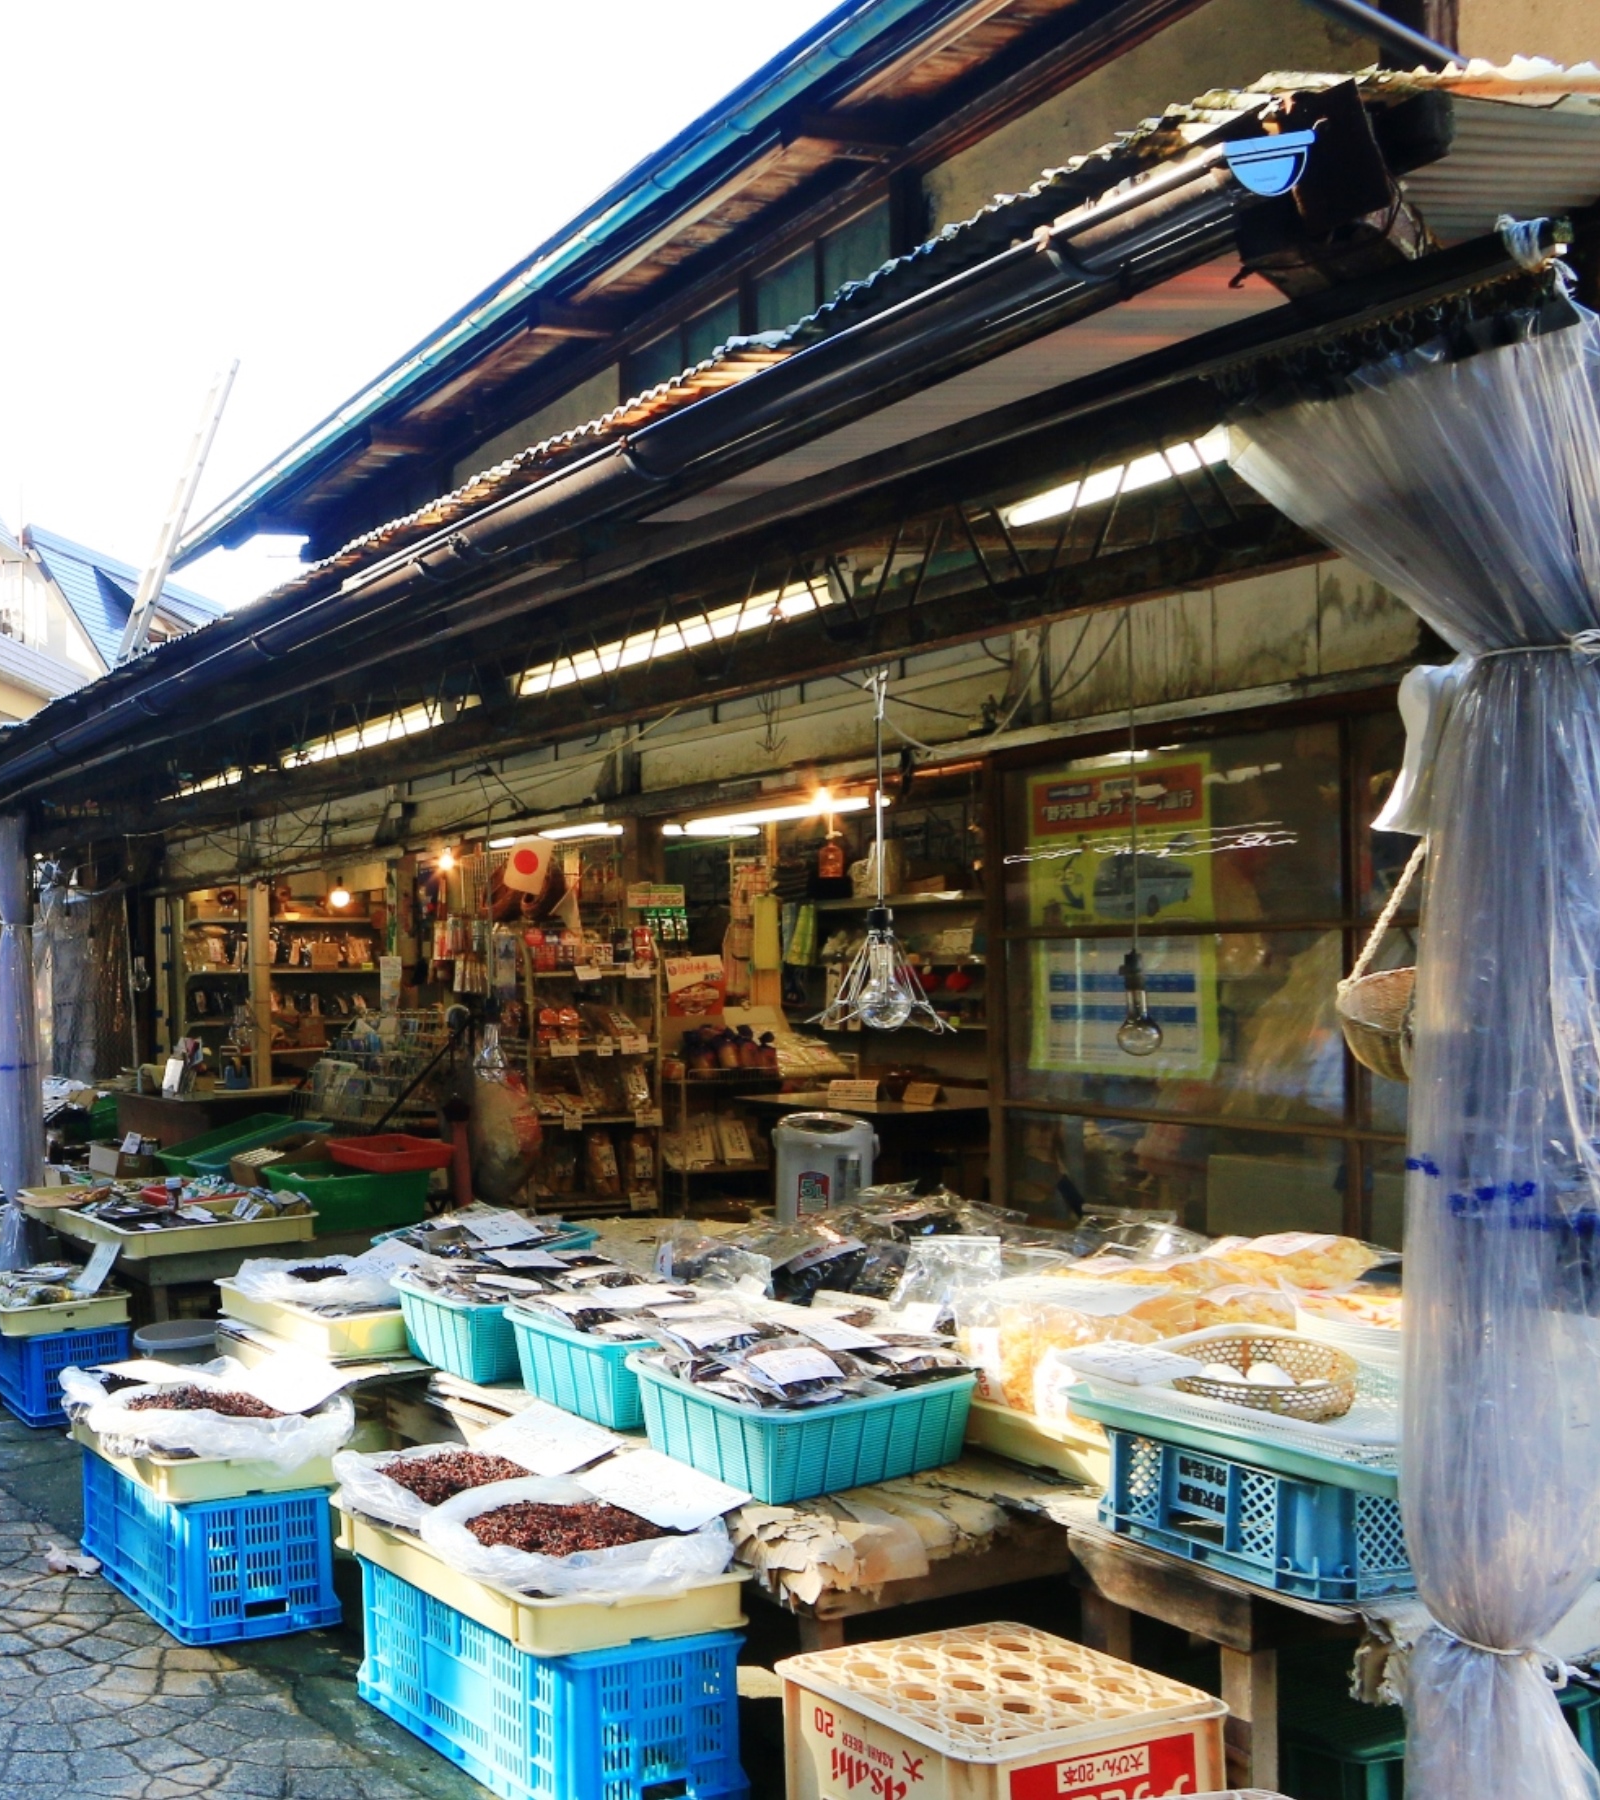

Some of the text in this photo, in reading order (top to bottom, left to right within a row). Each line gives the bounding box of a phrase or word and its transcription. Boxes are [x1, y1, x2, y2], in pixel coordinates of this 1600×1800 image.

[814, 1707, 835, 1739] 20
[831, 1746, 907, 1800] Asahi
[902, 1750, 924, 1783] 大
[1062, 1751, 1144, 1786] 大びん・20本
